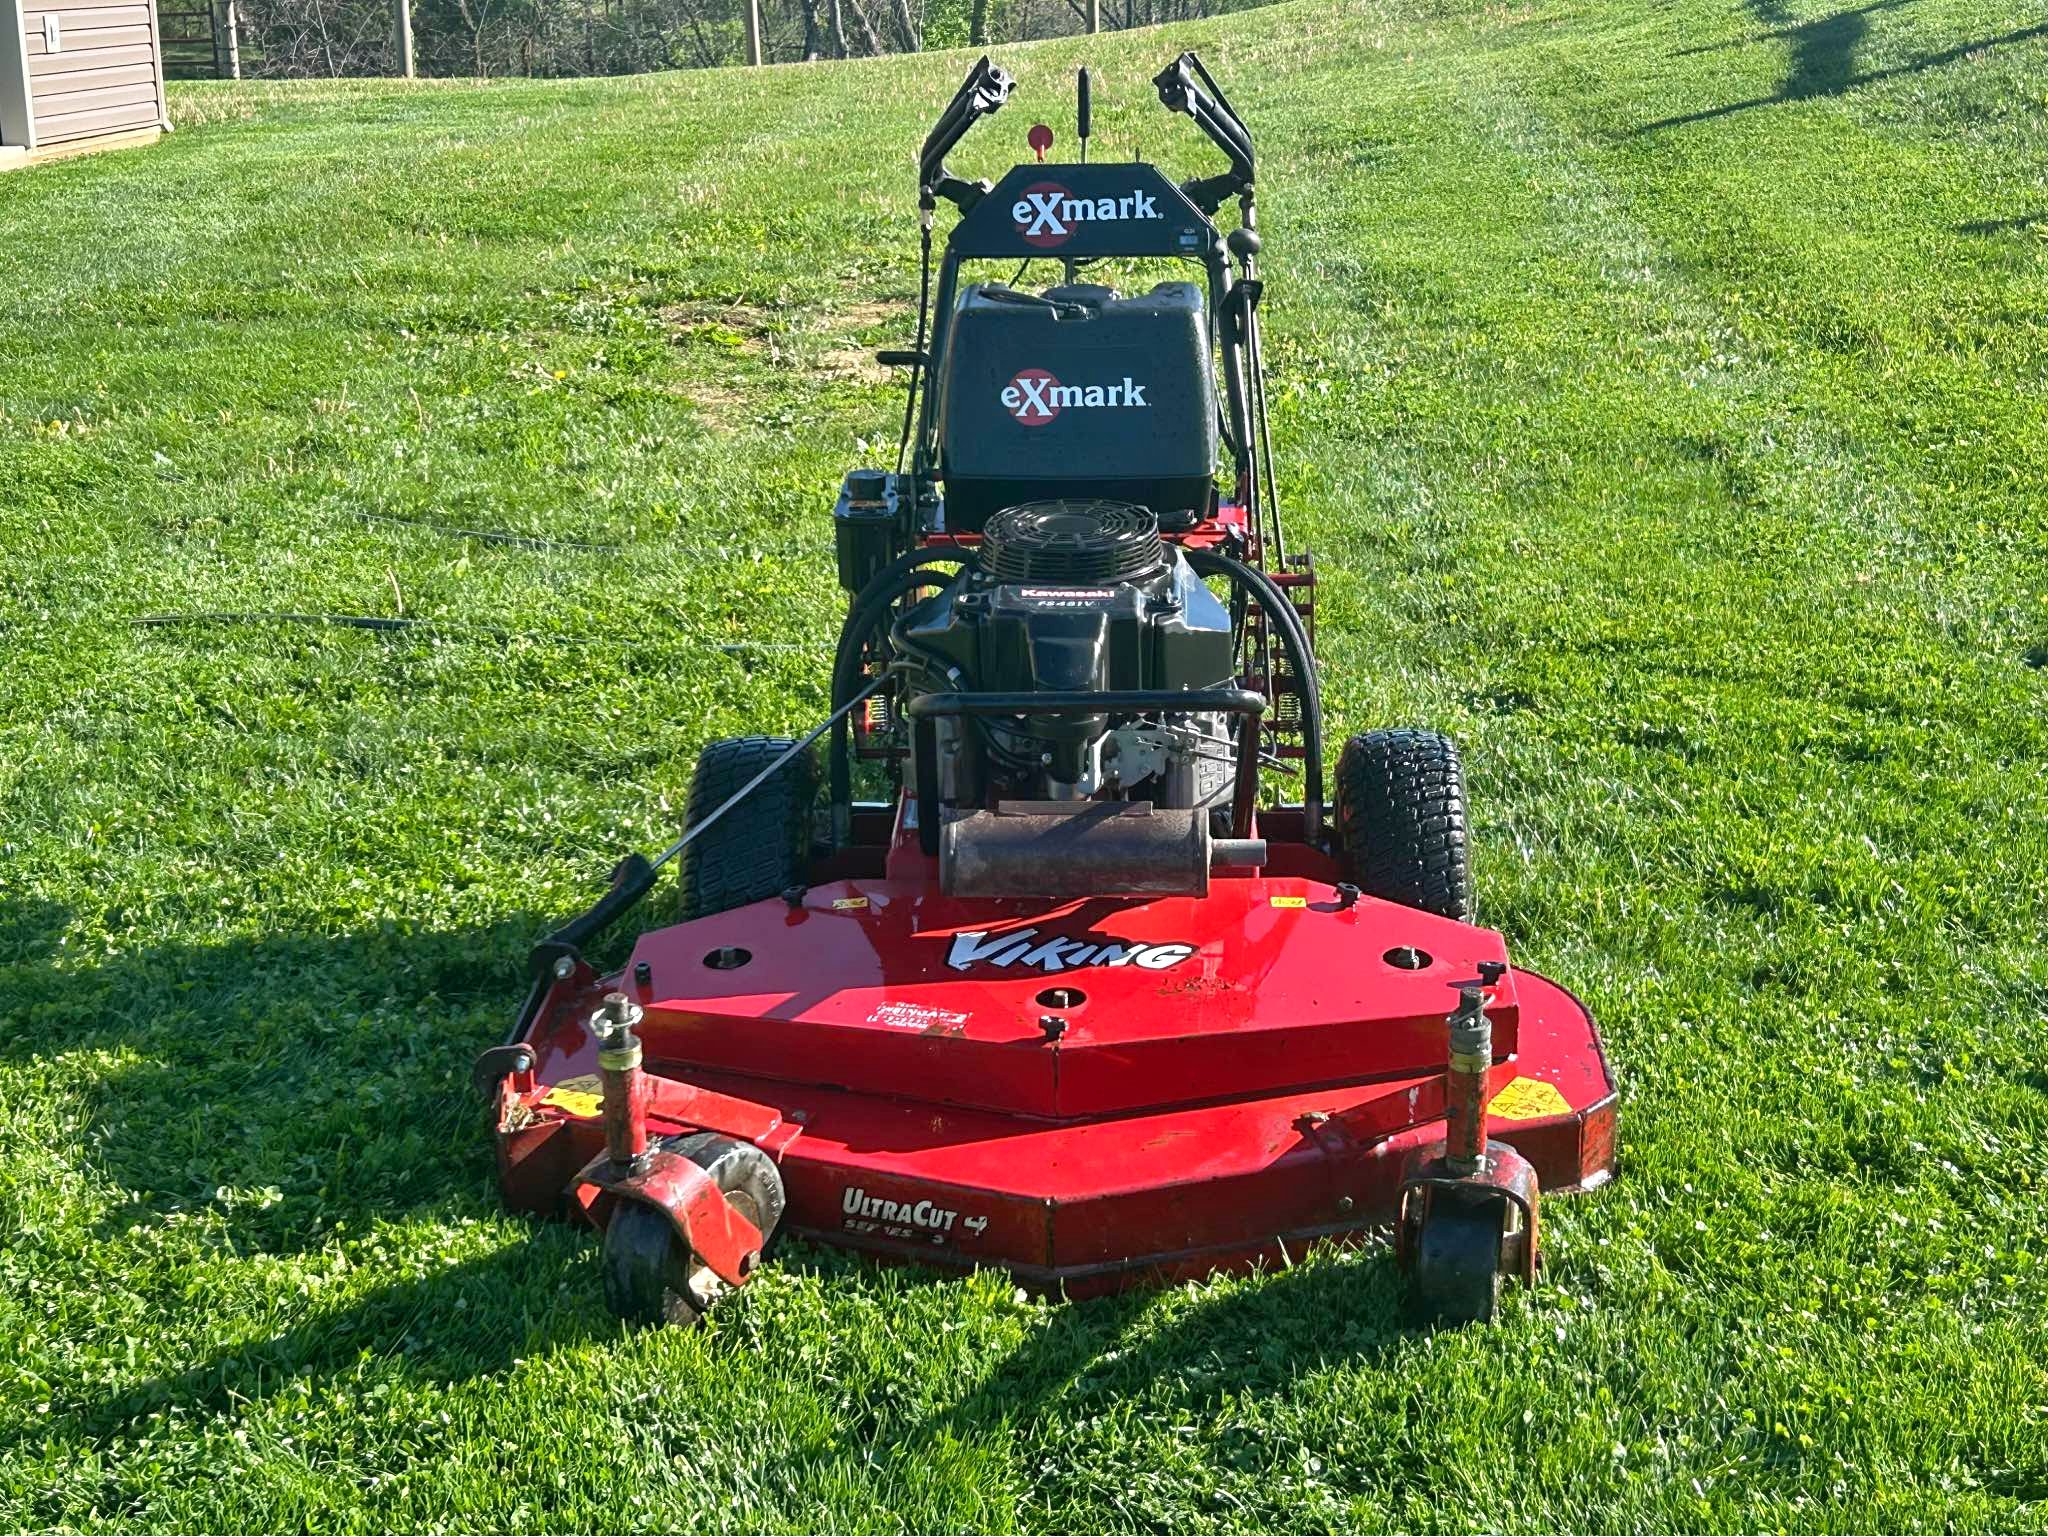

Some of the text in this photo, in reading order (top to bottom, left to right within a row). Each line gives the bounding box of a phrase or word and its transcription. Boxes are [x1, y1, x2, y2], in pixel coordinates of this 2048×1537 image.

[1012, 189, 1157, 236] eXmark
[1000, 377, 1147, 416] eXmark
[1021, 588, 1115, 598] Kawasaki
[948, 928, 1193, 971] VIKING
